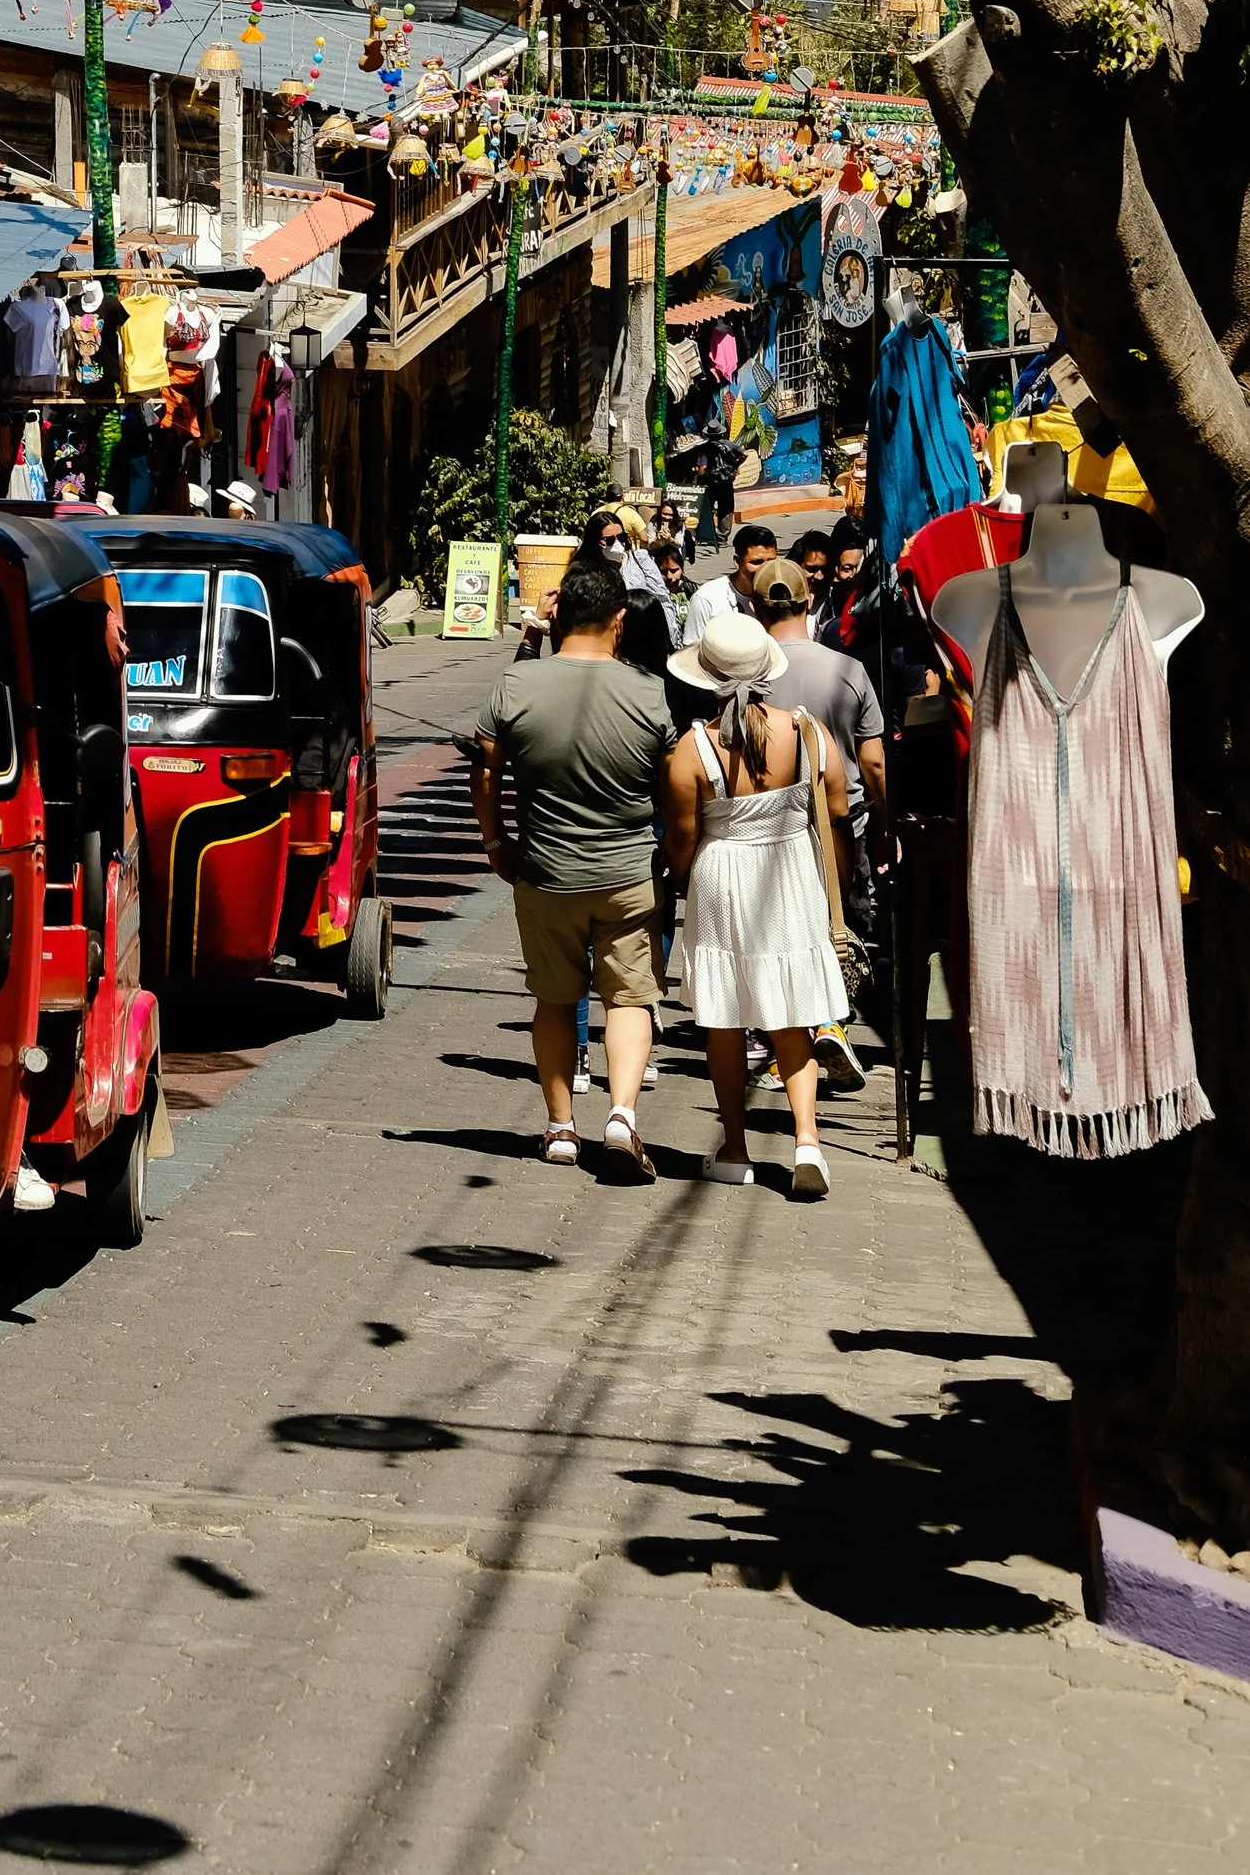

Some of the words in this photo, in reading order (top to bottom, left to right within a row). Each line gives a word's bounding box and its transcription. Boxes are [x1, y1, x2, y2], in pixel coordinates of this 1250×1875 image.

[855, 237, 869, 254] DE
[829, 293, 844, 319] SAN
[666, 492, 699, 502] Welcome
[452, 544, 497, 552] RESTAURANTE
[126, 655, 186, 686] UAN
[127, 713, 153, 732] er
